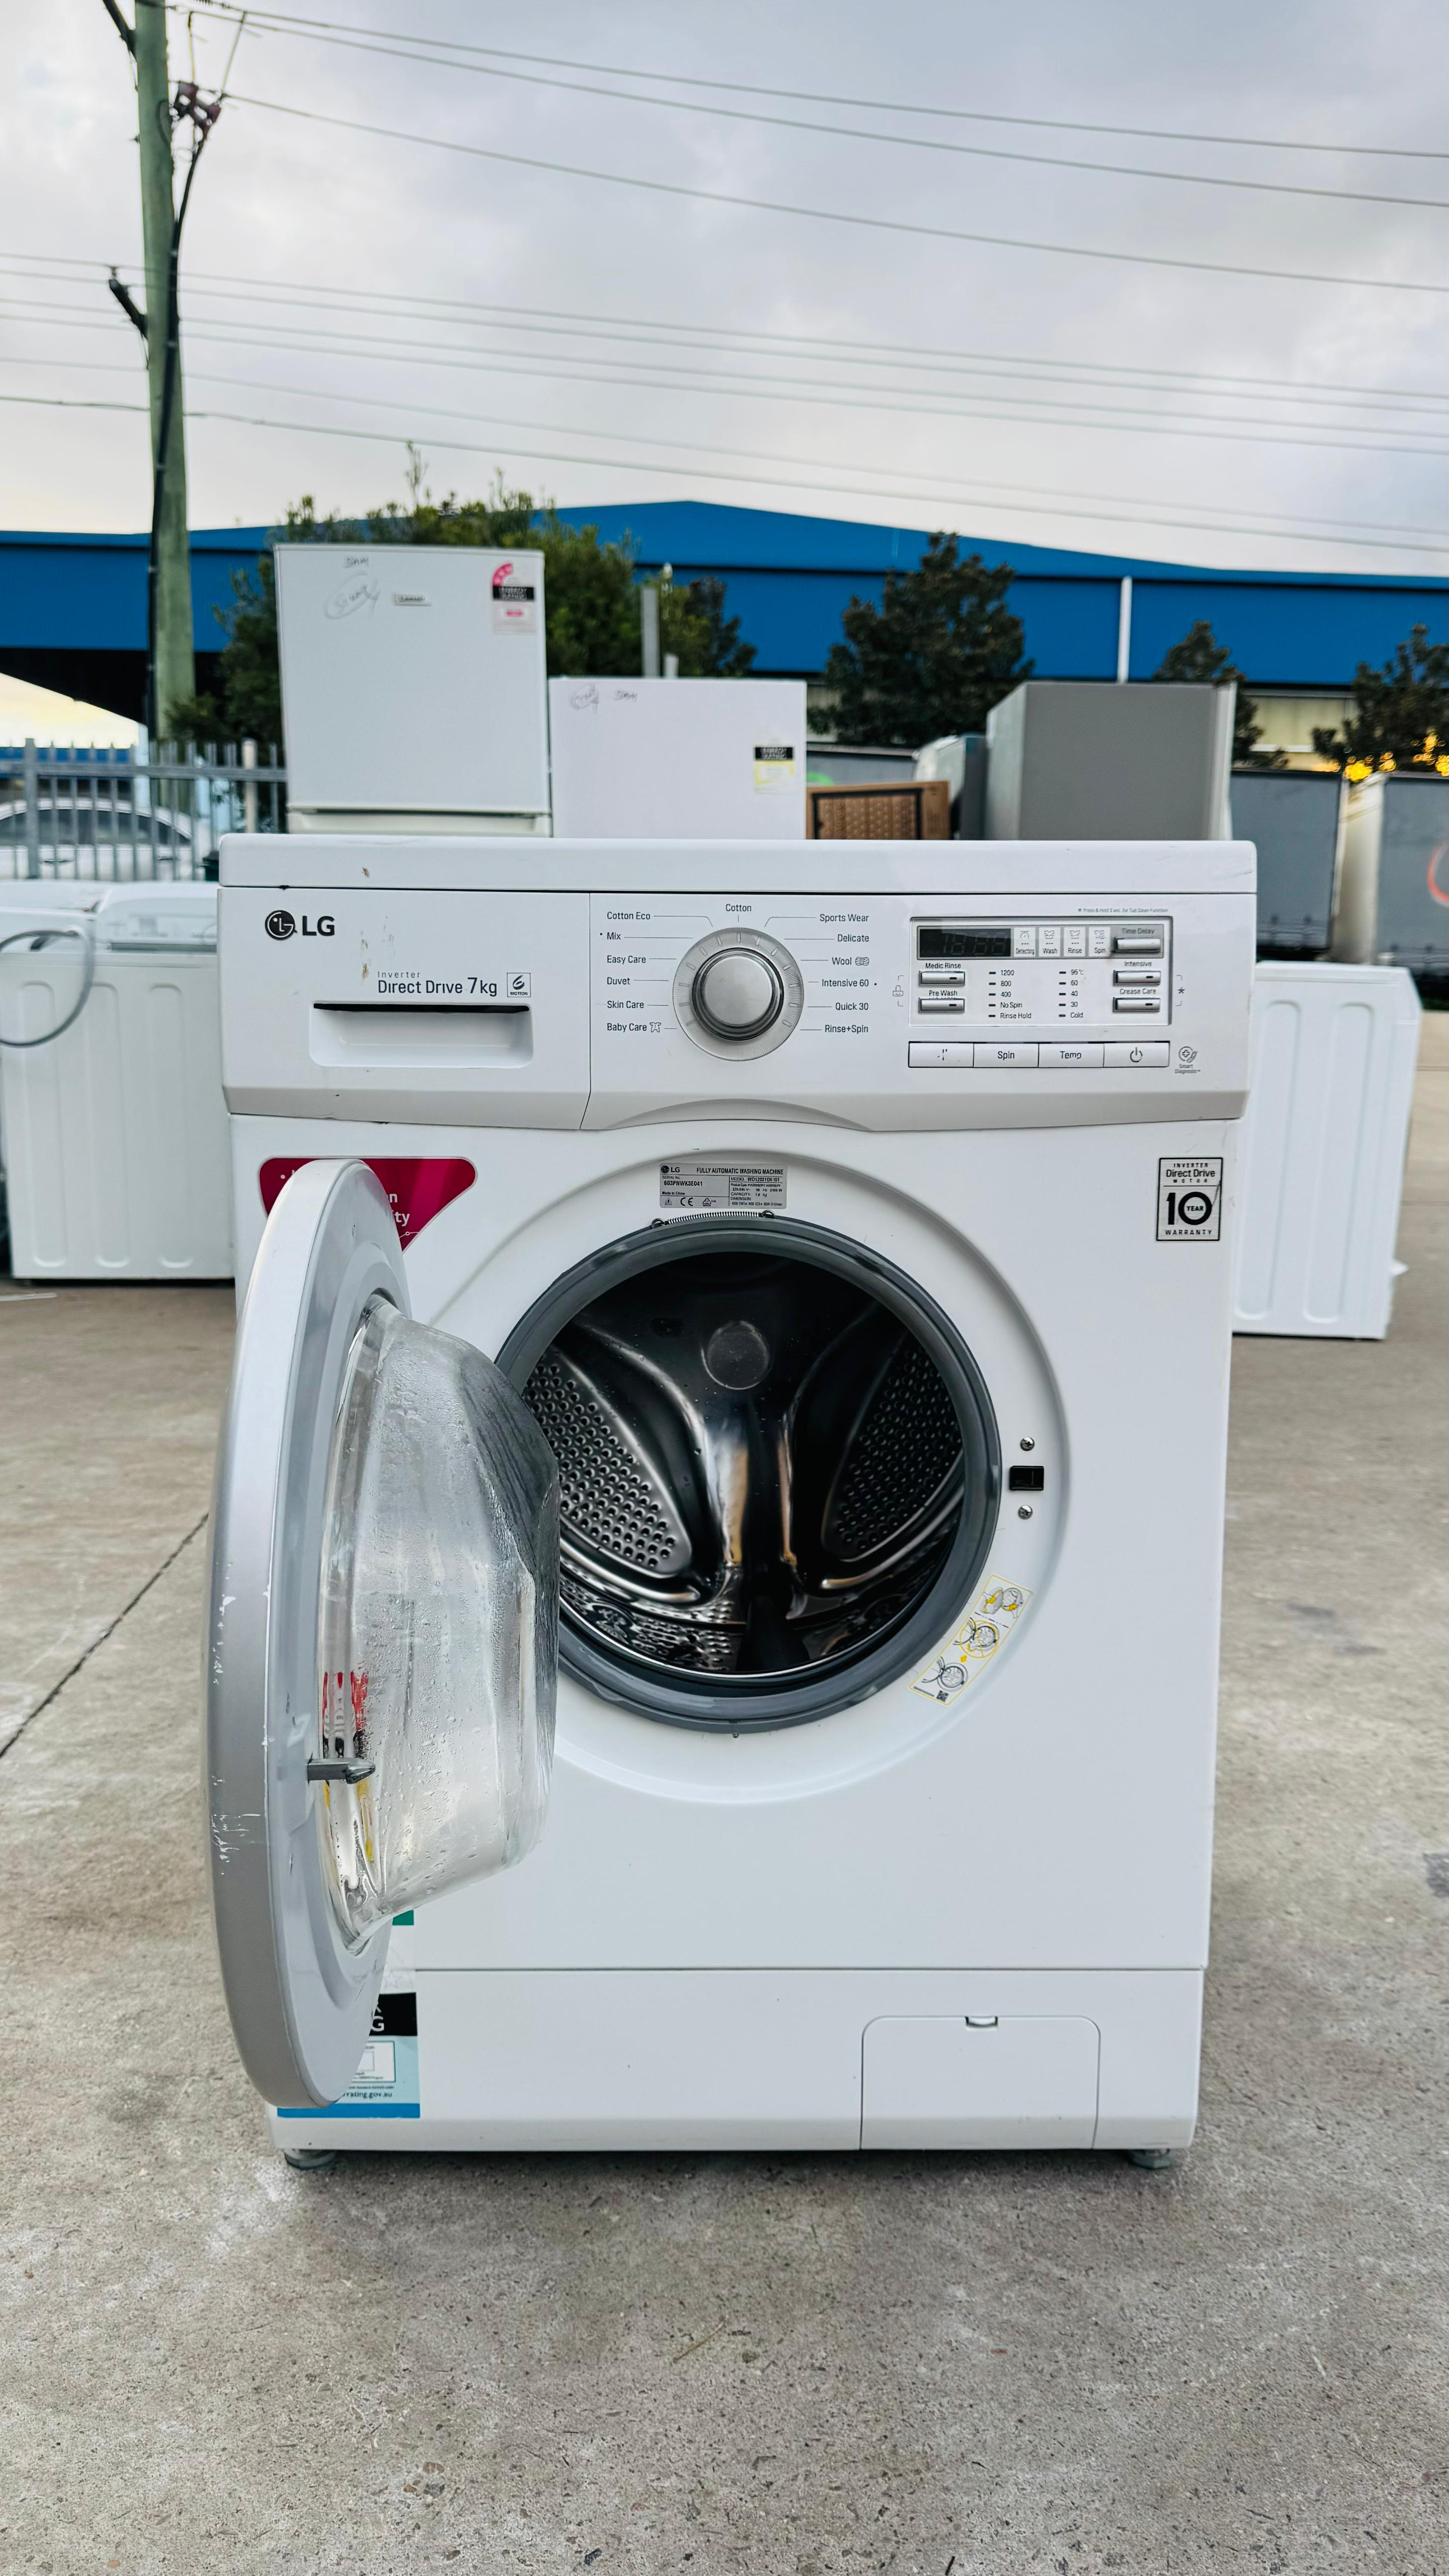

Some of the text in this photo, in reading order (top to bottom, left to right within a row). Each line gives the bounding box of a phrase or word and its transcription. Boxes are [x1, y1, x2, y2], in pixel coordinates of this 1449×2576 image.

[726, 904, 751, 912] Cotton
[820, 914, 845, 923] Sports
[302, 916, 335, 936] LG
[607, 956, 625, 964] Easy
[378, 980, 421, 994] Direct
[426, 980, 462, 994] Drive
[836, 1003, 856, 1011] Quick
[607, 1023, 647, 1032] Baby Care
[825, 1025, 868, 1033] Rinse+Spin
[998, 1052, 1014, 1060] Spin
[1060, 1051, 1081, 1059] Temp
[1166, 1192, 1212, 1225] 10
